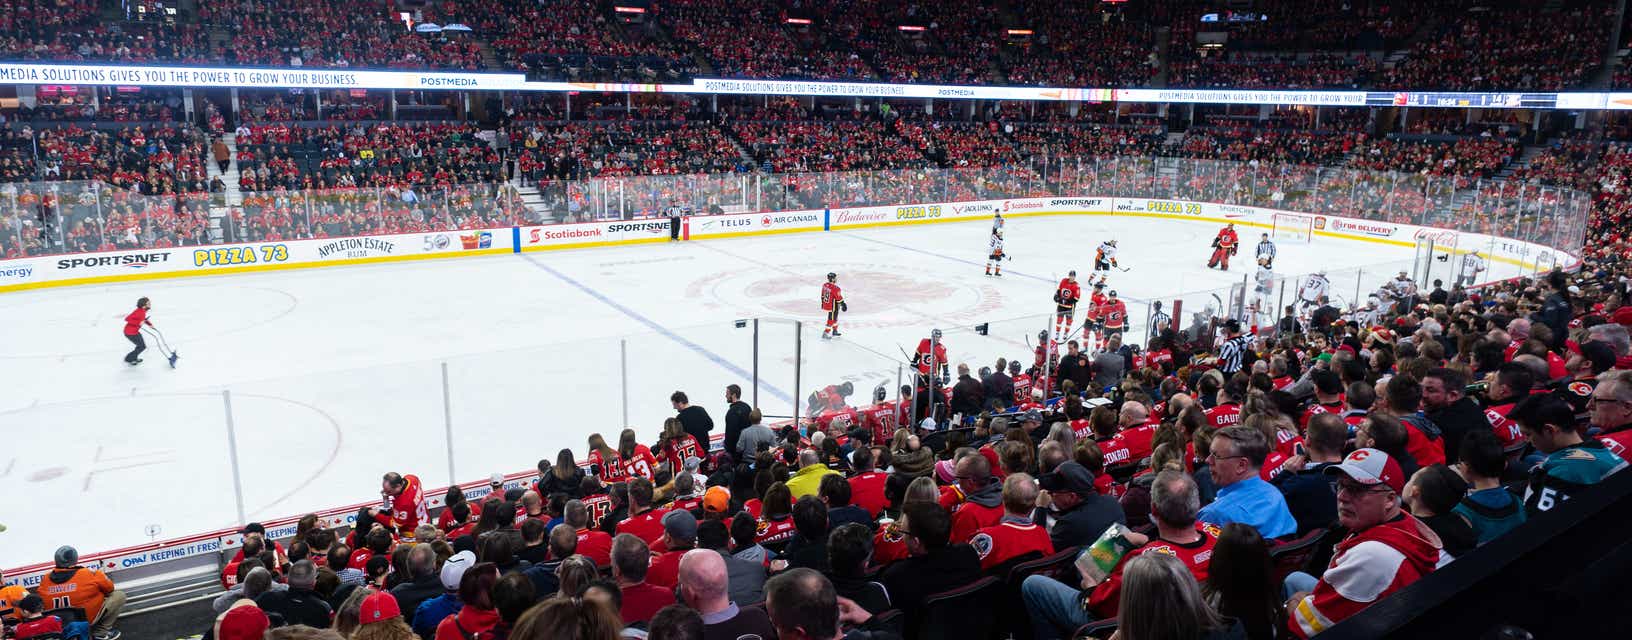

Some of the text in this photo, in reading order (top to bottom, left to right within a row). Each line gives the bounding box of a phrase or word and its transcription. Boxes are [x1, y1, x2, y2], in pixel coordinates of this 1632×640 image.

[0, 68, 38, 80] MEDIA
[42, 69, 105, 82] SOLUTIONS
[109, 70, 141, 82] GIVES
[145, 70, 166, 82] YOU
[170, 71, 189, 82] THE
[193, 72, 230, 83] POWER
[234, 72, 246, 83] TO
[250, 72, 279, 84] GROW
[283, 74, 309, 84] YOUR
[420, 77, 478, 86] POSTMEDIA
[705, 81, 740, 91] POSTMEDIA
[742, 82, 774, 92] SOLUTIONS
[1012, 201, 1044, 210] Scotiabank
[1050, 199, 1102, 207] SPORTSNET
[1147, 201, 1202, 215] PIZZA 73
[786, 214, 818, 223] CANADA
[896, 206, 942, 219] PIZZA 73
[608, 221, 672, 233] SPORTSNE
[720, 218, 752, 227] TELUS
[544, 228, 601, 241] Scotiabank
[1357, 225, 1392, 234] DELIVERY
[318, 237, 396, 259] APPLETON ESTATE
[57, 252, 171, 270] SPORTSNET
[194, 244, 289, 266] PIZZA 73
[1308, 279, 1322, 290] 37
[1103, 447, 1131, 466] CONROY
[464, 487, 492, 500] KEEPING
[265, 527, 297, 539] KEEPING
[122, 553, 148, 568] OPA!
[150, 548, 186, 562] KEEPING
[187, 546, 196, 557] IT
[22, 574, 45, 587] KEEP
